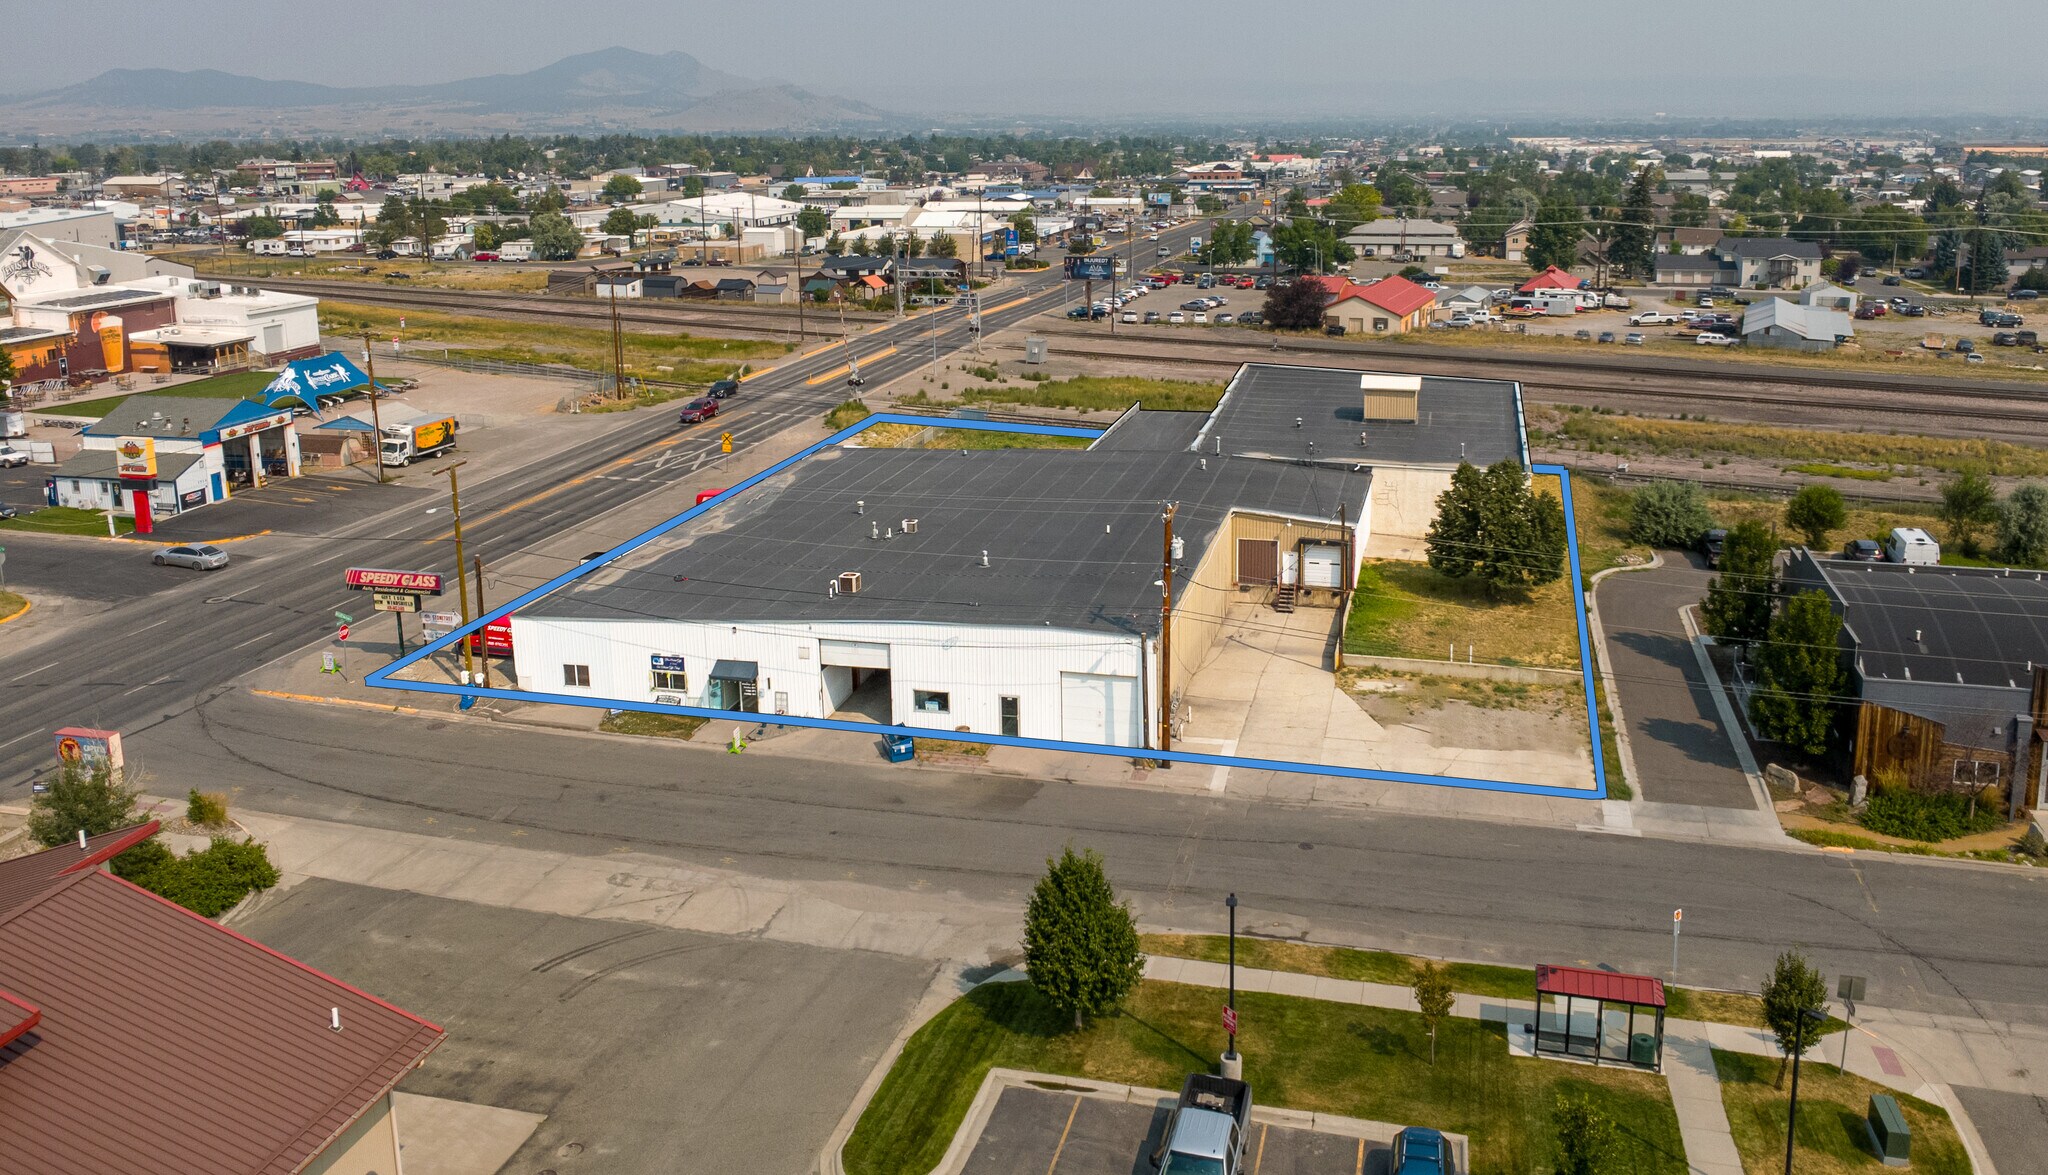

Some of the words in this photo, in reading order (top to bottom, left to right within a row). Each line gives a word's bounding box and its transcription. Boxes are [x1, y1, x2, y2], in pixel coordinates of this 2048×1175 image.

[359, 571, 401, 585] SPEEDY
[401, 574, 436, 588] GLASS
[339, 628, 349, 637] STOP
[487, 625, 507, 633] SPEEDY
